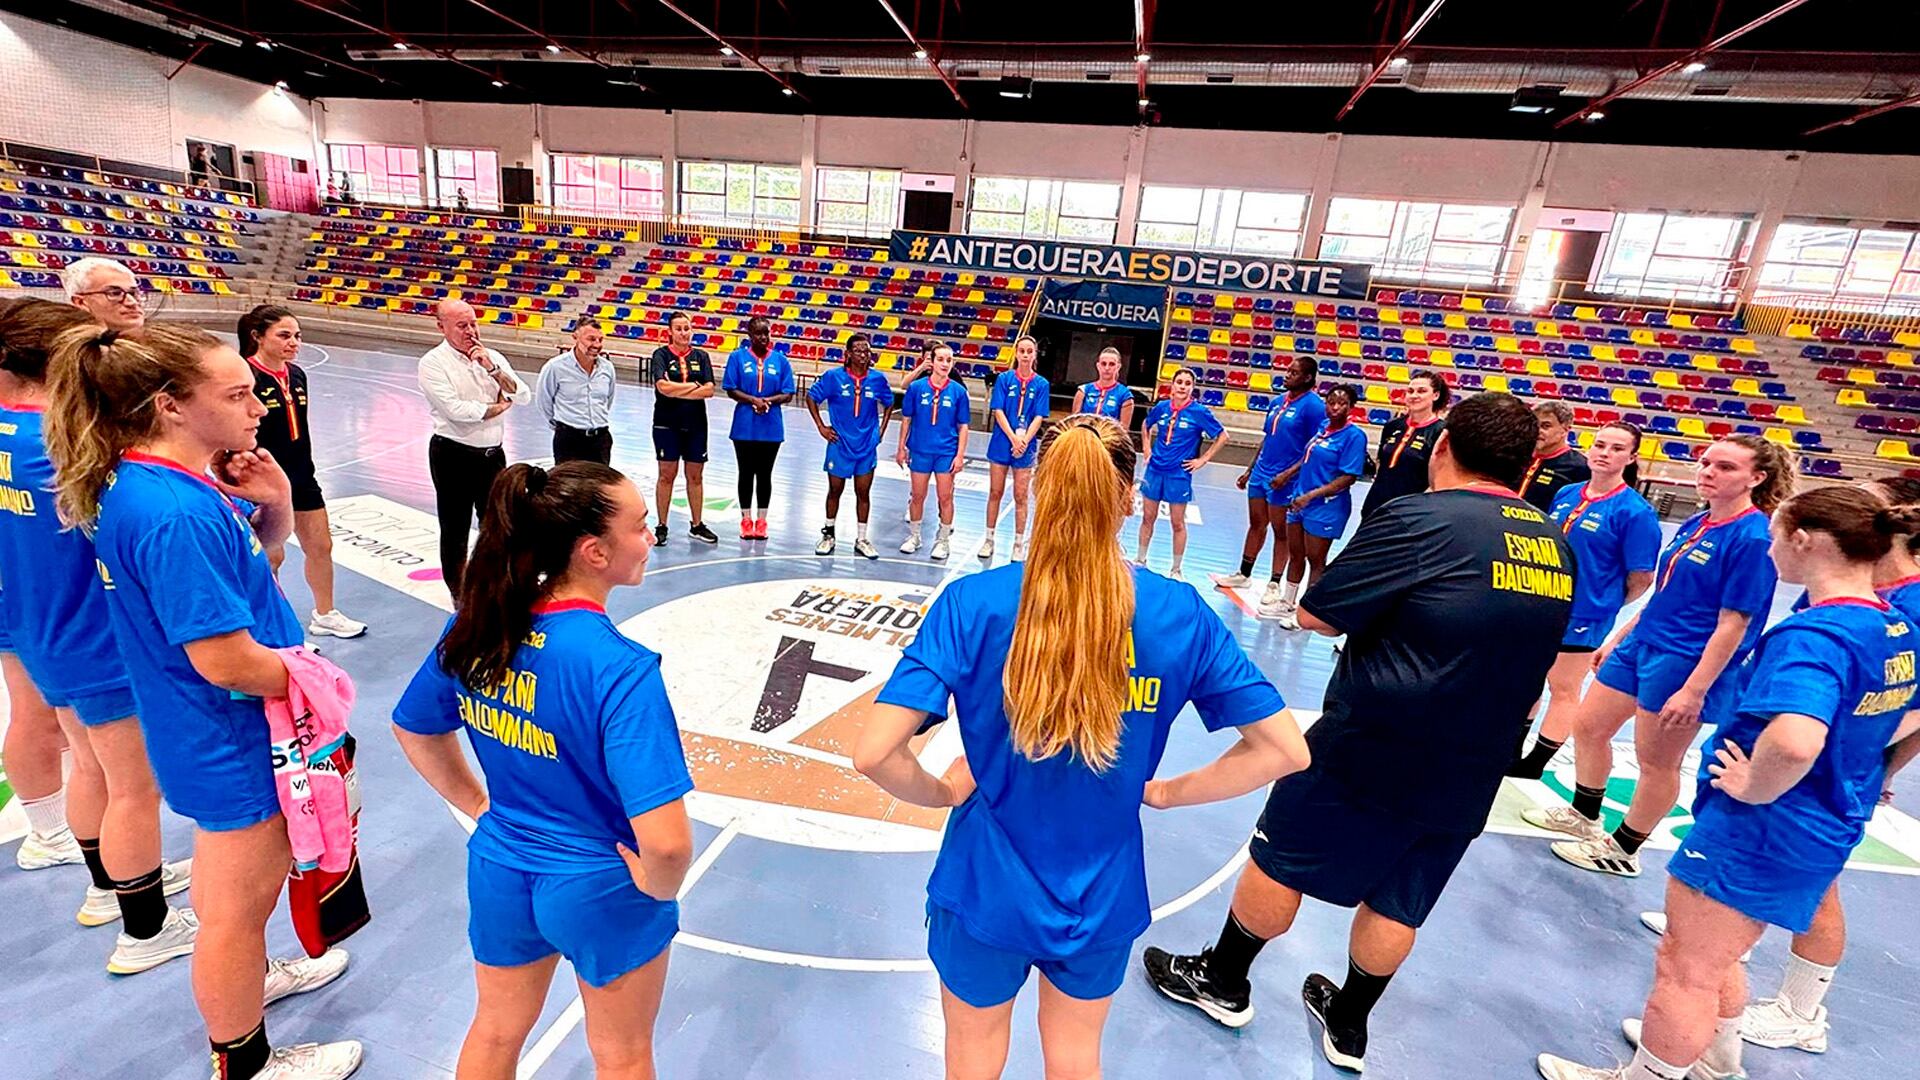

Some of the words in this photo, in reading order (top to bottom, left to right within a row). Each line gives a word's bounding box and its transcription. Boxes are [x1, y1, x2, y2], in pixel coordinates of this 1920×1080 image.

[909, 235, 1343, 295] #ANTEQUERAESDEPORTE
[1042, 298, 1160, 324] ANTEQUERA
[1503, 531, 1562, 569] ESPAÑA
[1492, 560, 1573, 602] BALONMANO
[790, 590, 923, 630] QUERA
